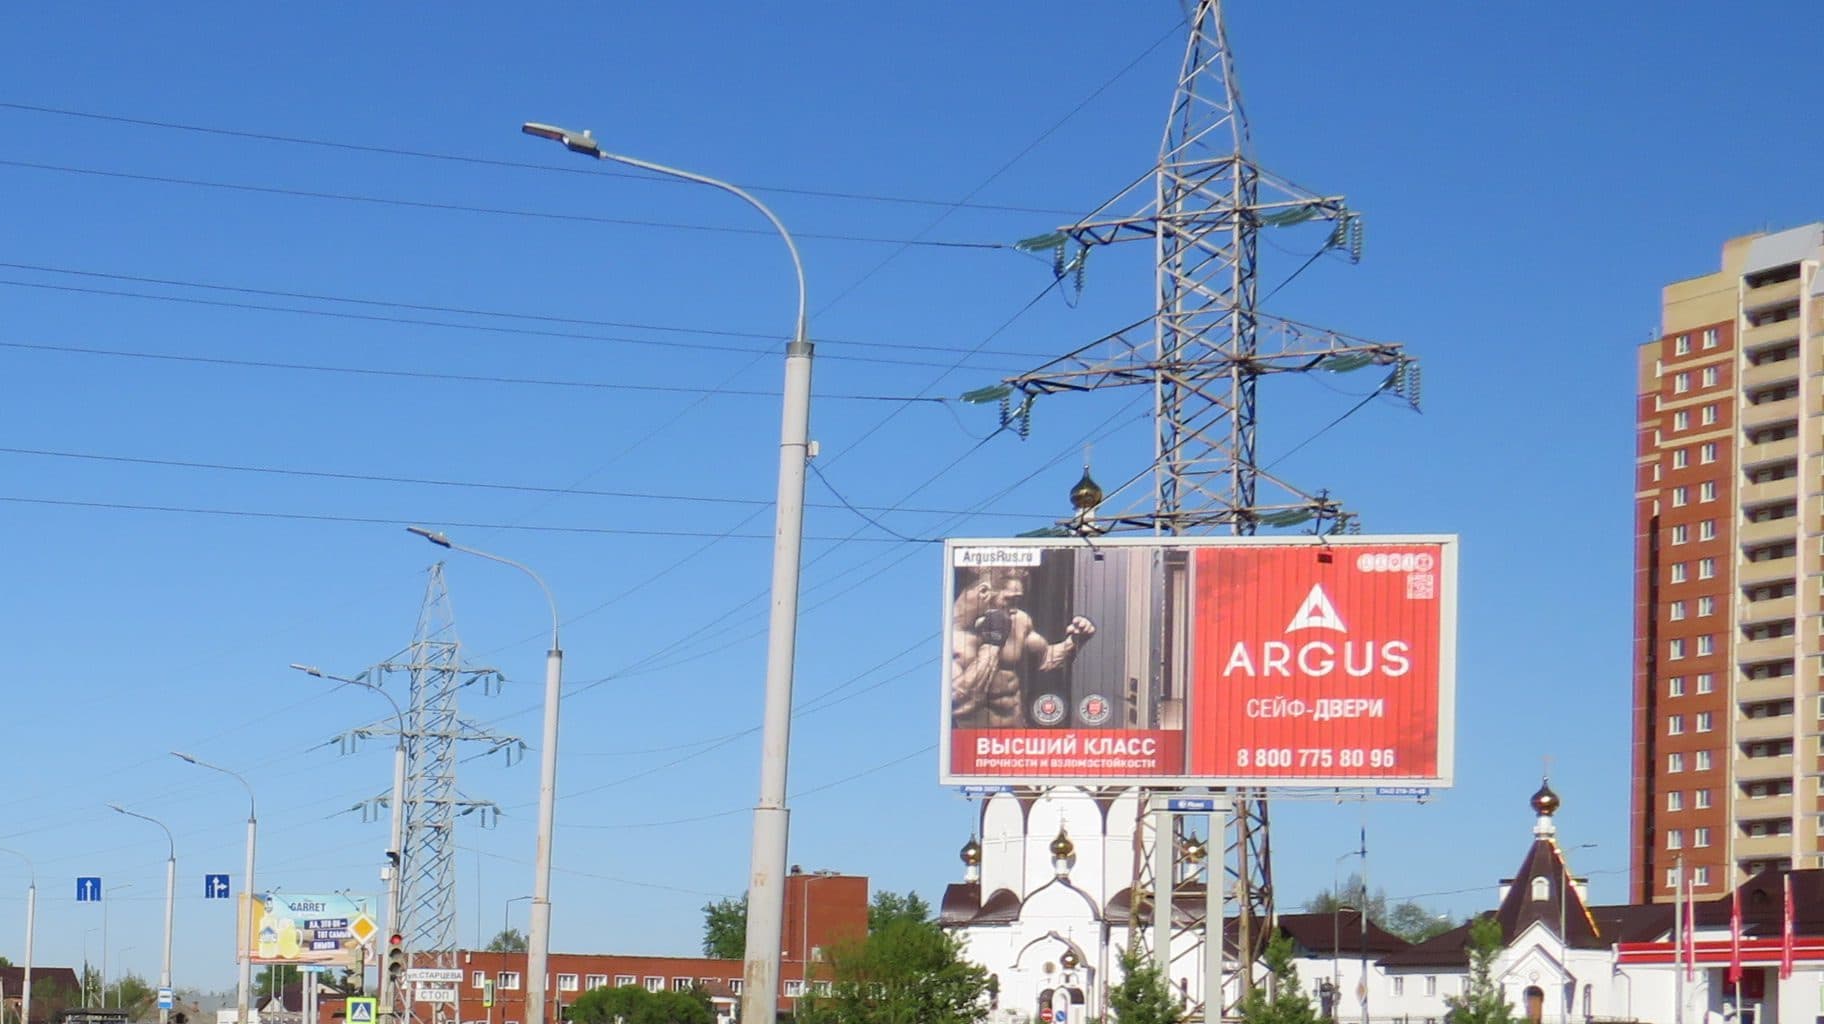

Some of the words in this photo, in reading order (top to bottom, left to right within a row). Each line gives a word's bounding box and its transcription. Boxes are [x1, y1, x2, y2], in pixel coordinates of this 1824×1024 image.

[963, 550, 1033, 564] ArgusRus.ru
[1222, 640, 1410, 677] ARGUS
[1246, 696, 1384, 721] СЕЙФ-ДВЕРИ
[976, 735, 1076, 755] ВЫСШИЙ
[1084, 738, 1156, 755] КЛАСС
[975, 759, 1038, 768] ПРОЧНОСТИ
[1040, 759, 1048, 768] И
[1050, 757, 1156, 768] ВЗЛОМОСТОЙКОСТИ
[1236, 749, 1249, 767] 8
[1255, 749, 1292, 767] 800
[1298, 749, 1333, 767] 775
[1339, 749, 1364, 767] 80
[1370, 749, 1394, 767] 96
[291, 902, 327, 912] GARRET
[421, 990, 449, 1000] СТОП
